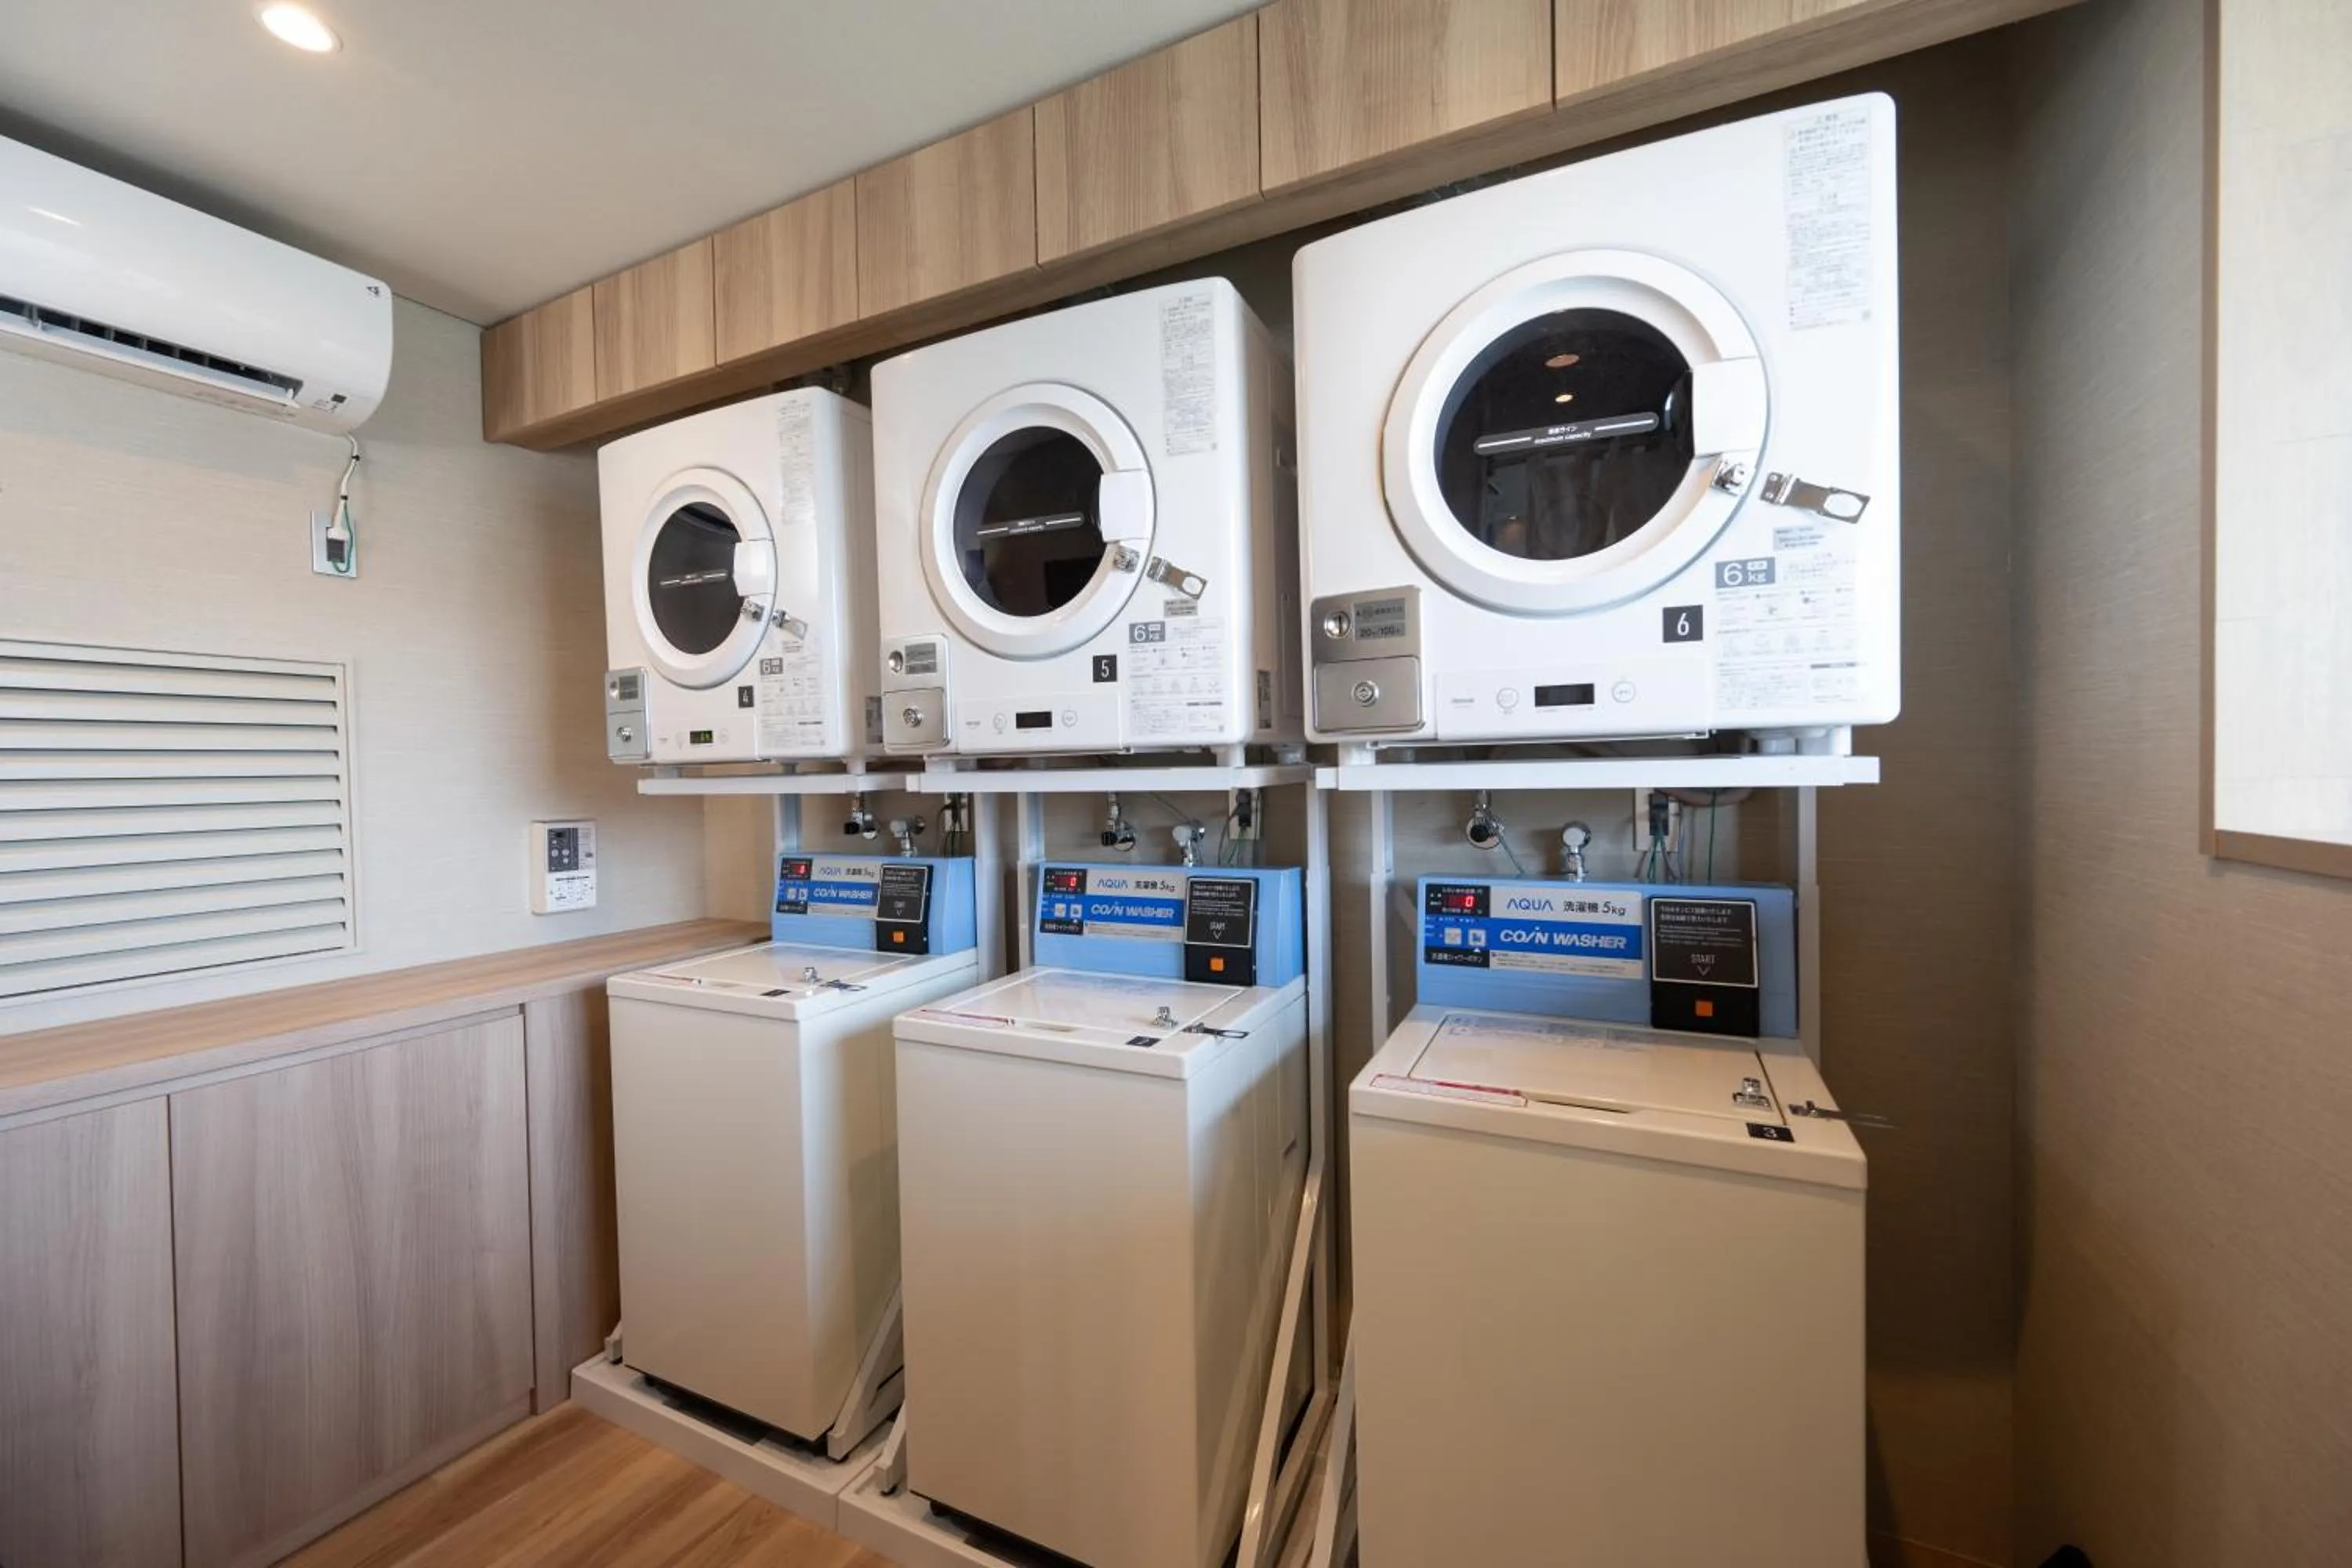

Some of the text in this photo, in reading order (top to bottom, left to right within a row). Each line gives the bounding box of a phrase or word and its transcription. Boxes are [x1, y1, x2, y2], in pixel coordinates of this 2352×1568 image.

[1723, 562, 1743, 586] 6
[1748, 571, 1766, 583] kg
[1677, 612, 1690, 636] 6
[1134, 625, 1146, 641] 6
[1101, 659, 1109, 678] 5
[1098, 878, 1128, 889] AQUA
[1091, 901, 1174, 918] COIN WASHER
[1465, 895, 1474, 907] 0
[1506, 898, 1625, 916] AQUA 洗濯機 5kg
[1500, 926, 1627, 949] COIN WASHER
[1691, 953, 1716, 964] START
[1762, 1127, 1777, 1138] 3
